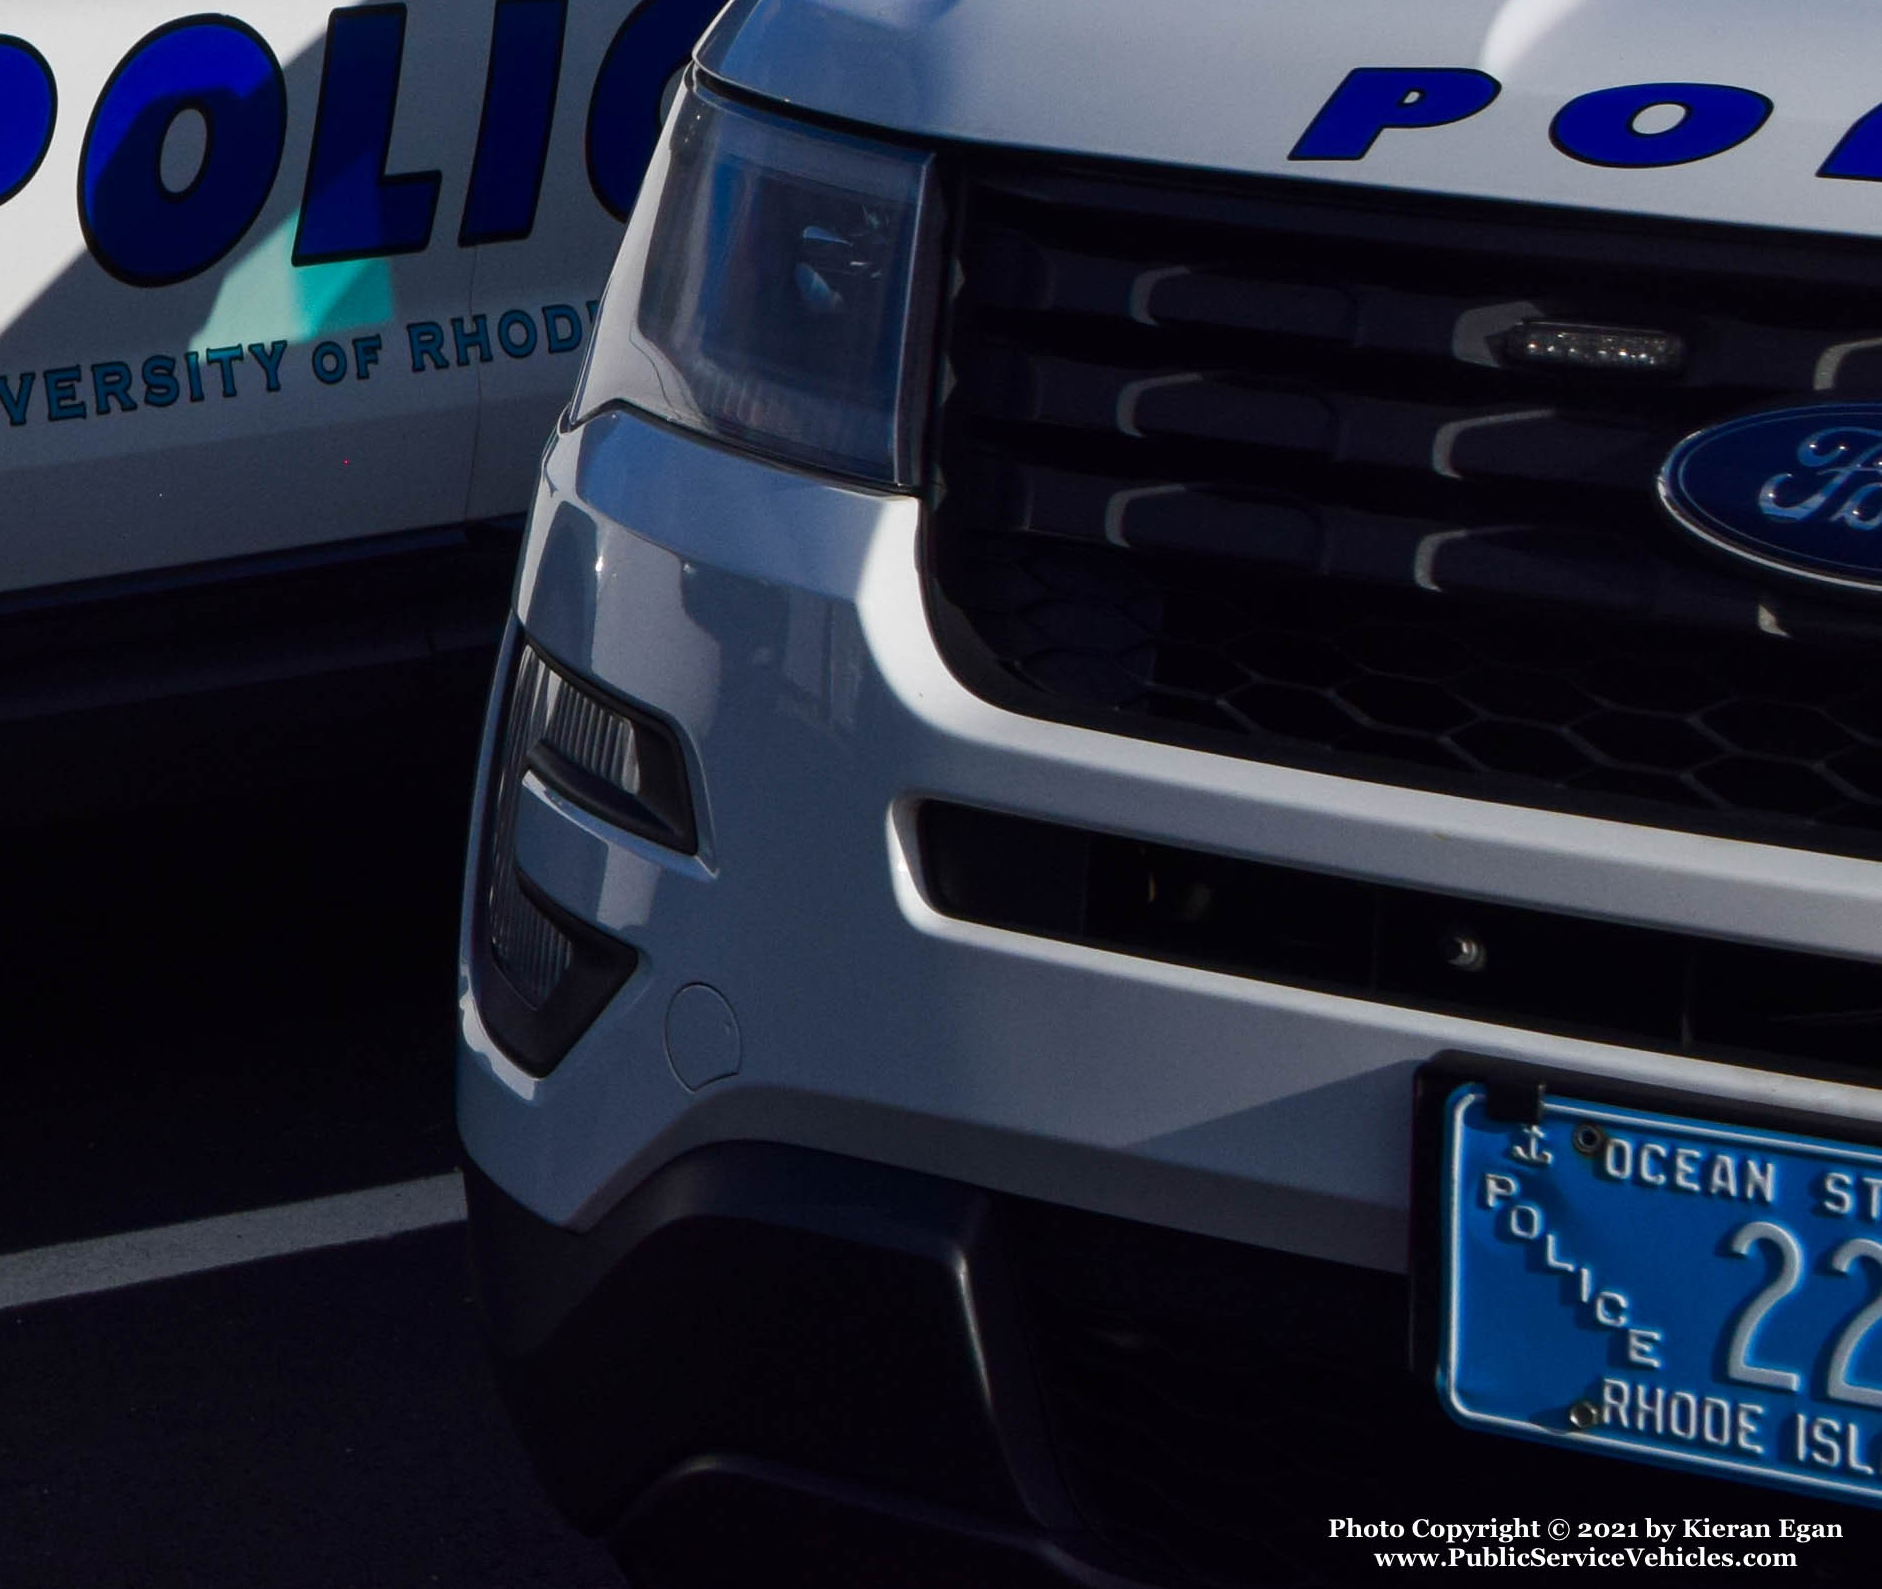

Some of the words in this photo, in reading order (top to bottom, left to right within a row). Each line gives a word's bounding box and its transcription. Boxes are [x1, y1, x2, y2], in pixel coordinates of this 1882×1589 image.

[310, 334, 382, 386] OF
[407, 298, 599, 374] RHOD
[1604, 1137, 1777, 1203] OCEAN
[1485, 1172, 1662, 1369] POLICE
[1602, 1378, 1765, 1454] RHODE
